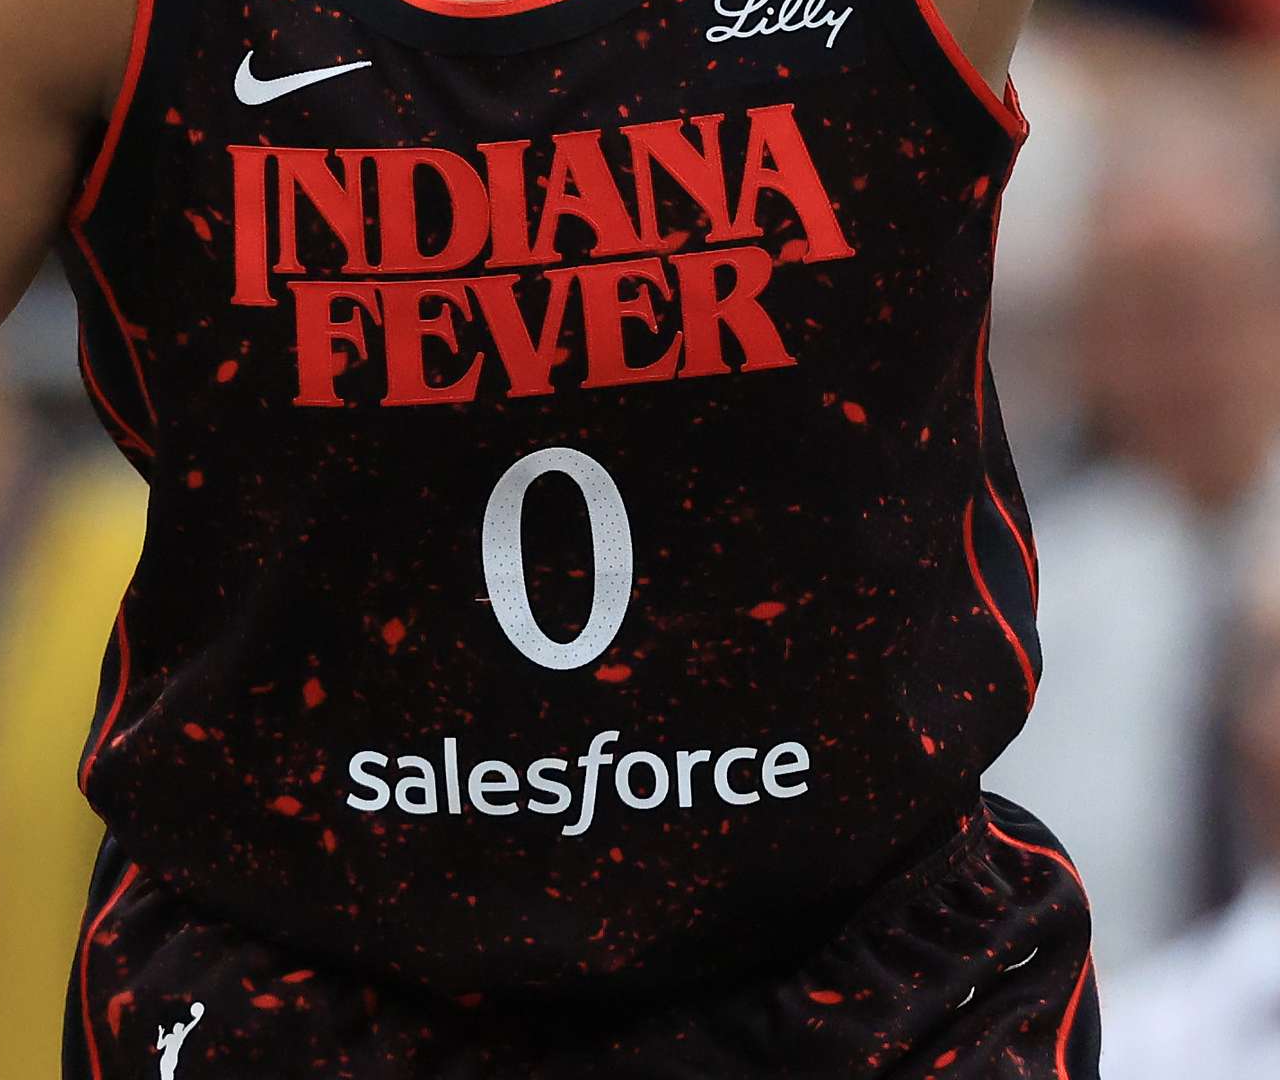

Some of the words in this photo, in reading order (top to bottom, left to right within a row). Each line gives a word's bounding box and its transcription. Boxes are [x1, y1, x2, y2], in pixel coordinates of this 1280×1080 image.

[226, 103, 856, 307] INDIANA
[287, 245, 798, 408] FEVER
[481, 446, 634, 670] 0
[345, 730, 811, 837] salesforce
